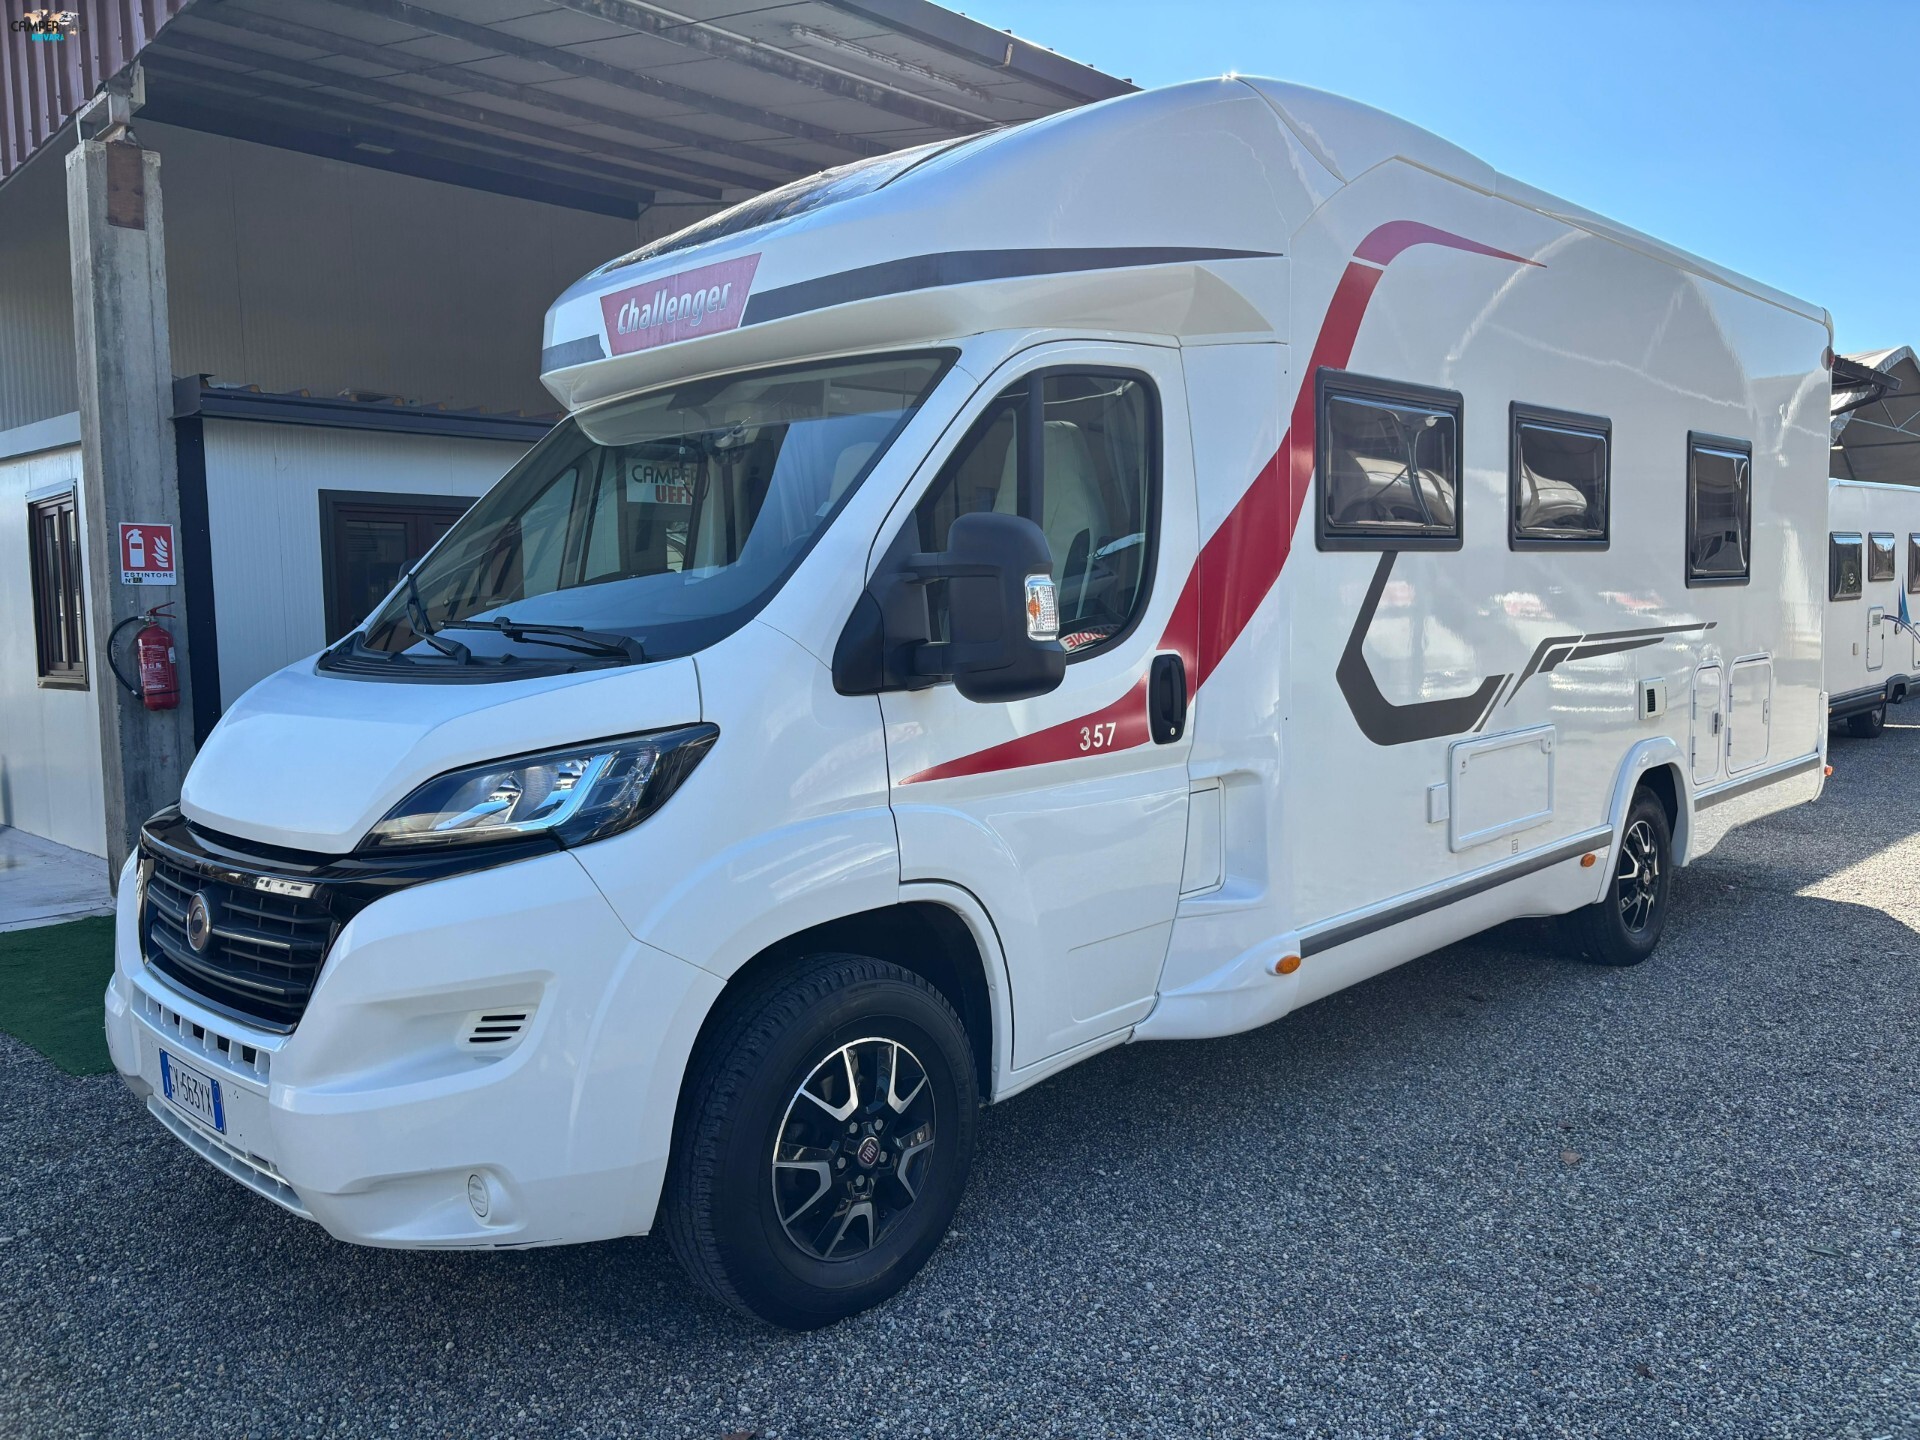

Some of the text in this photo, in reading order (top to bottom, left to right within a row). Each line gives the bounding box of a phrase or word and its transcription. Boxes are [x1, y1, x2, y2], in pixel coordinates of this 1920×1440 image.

[617, 282, 732, 335] Challenger
[1080, 722, 1116, 751] 357
[862, 1141, 876, 1162] FIAT
